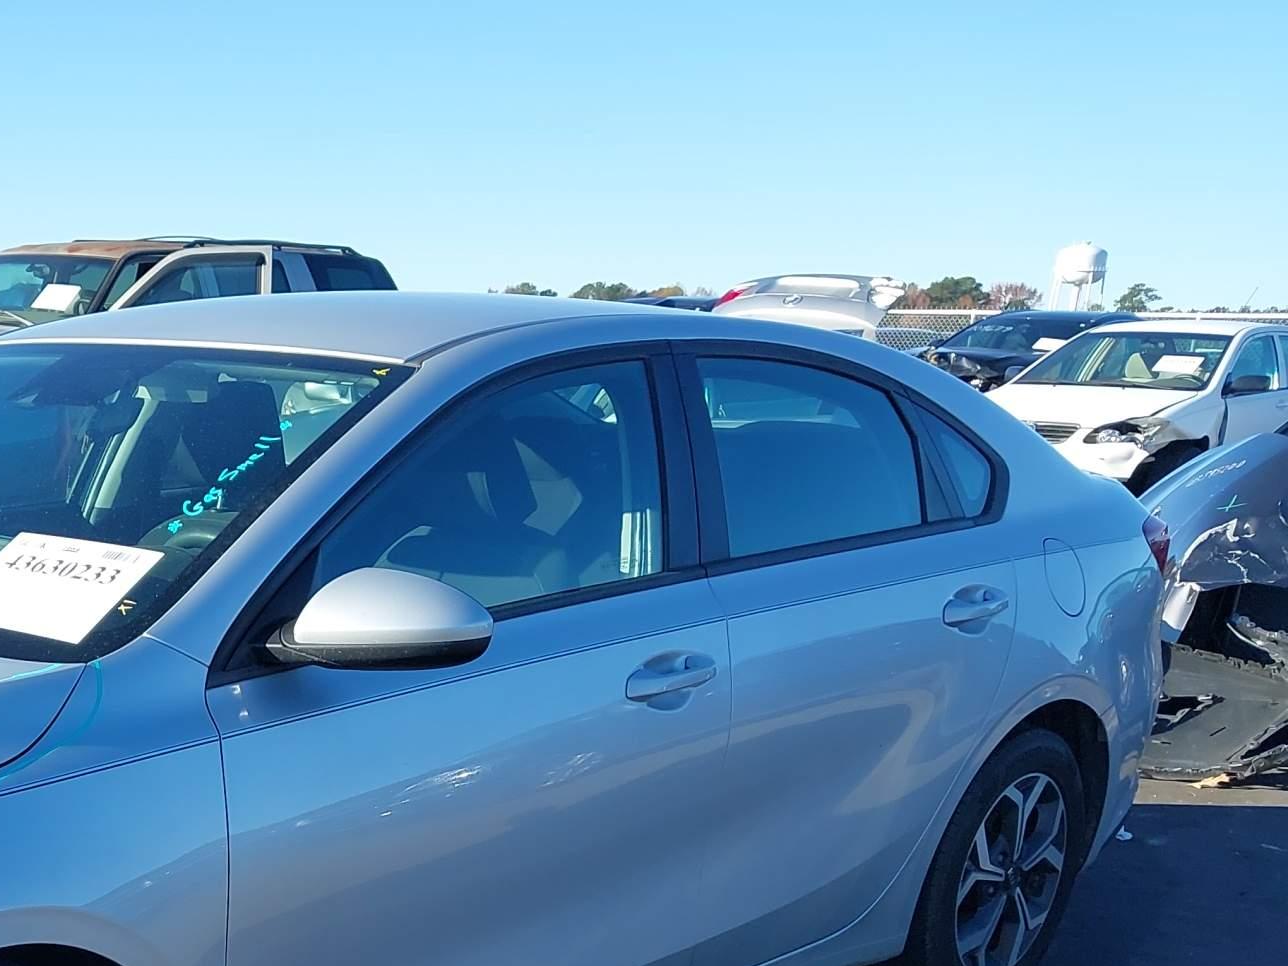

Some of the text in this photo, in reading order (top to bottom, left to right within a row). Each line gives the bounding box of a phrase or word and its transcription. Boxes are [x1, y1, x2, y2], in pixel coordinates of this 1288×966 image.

[182, 436, 282, 516] Gas Smell
[5, 553, 121, 584] 43630233
